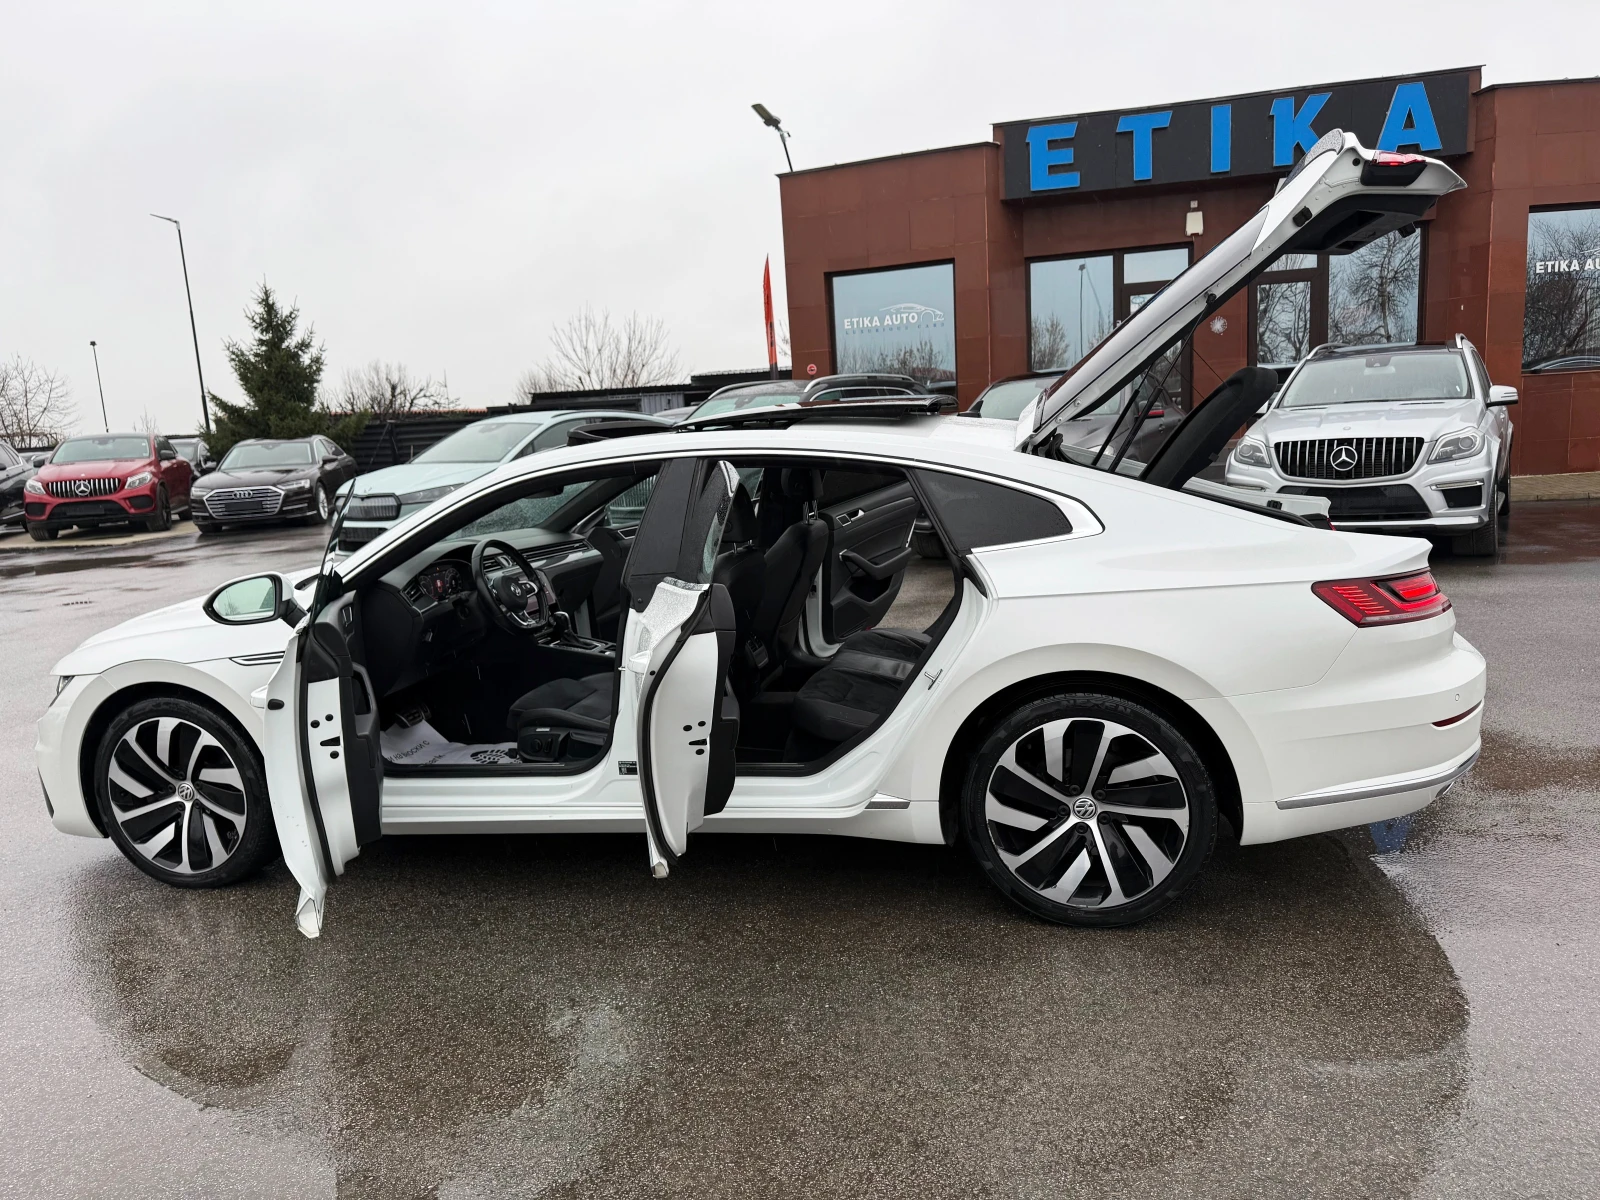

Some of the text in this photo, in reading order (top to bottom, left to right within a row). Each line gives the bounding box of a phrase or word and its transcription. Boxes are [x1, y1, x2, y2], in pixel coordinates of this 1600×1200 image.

[1026, 81, 1442, 192] ETIKA
[1536, 260, 1580, 273] ETIKA
[844, 313, 918, 329] ETIKA AUTO
